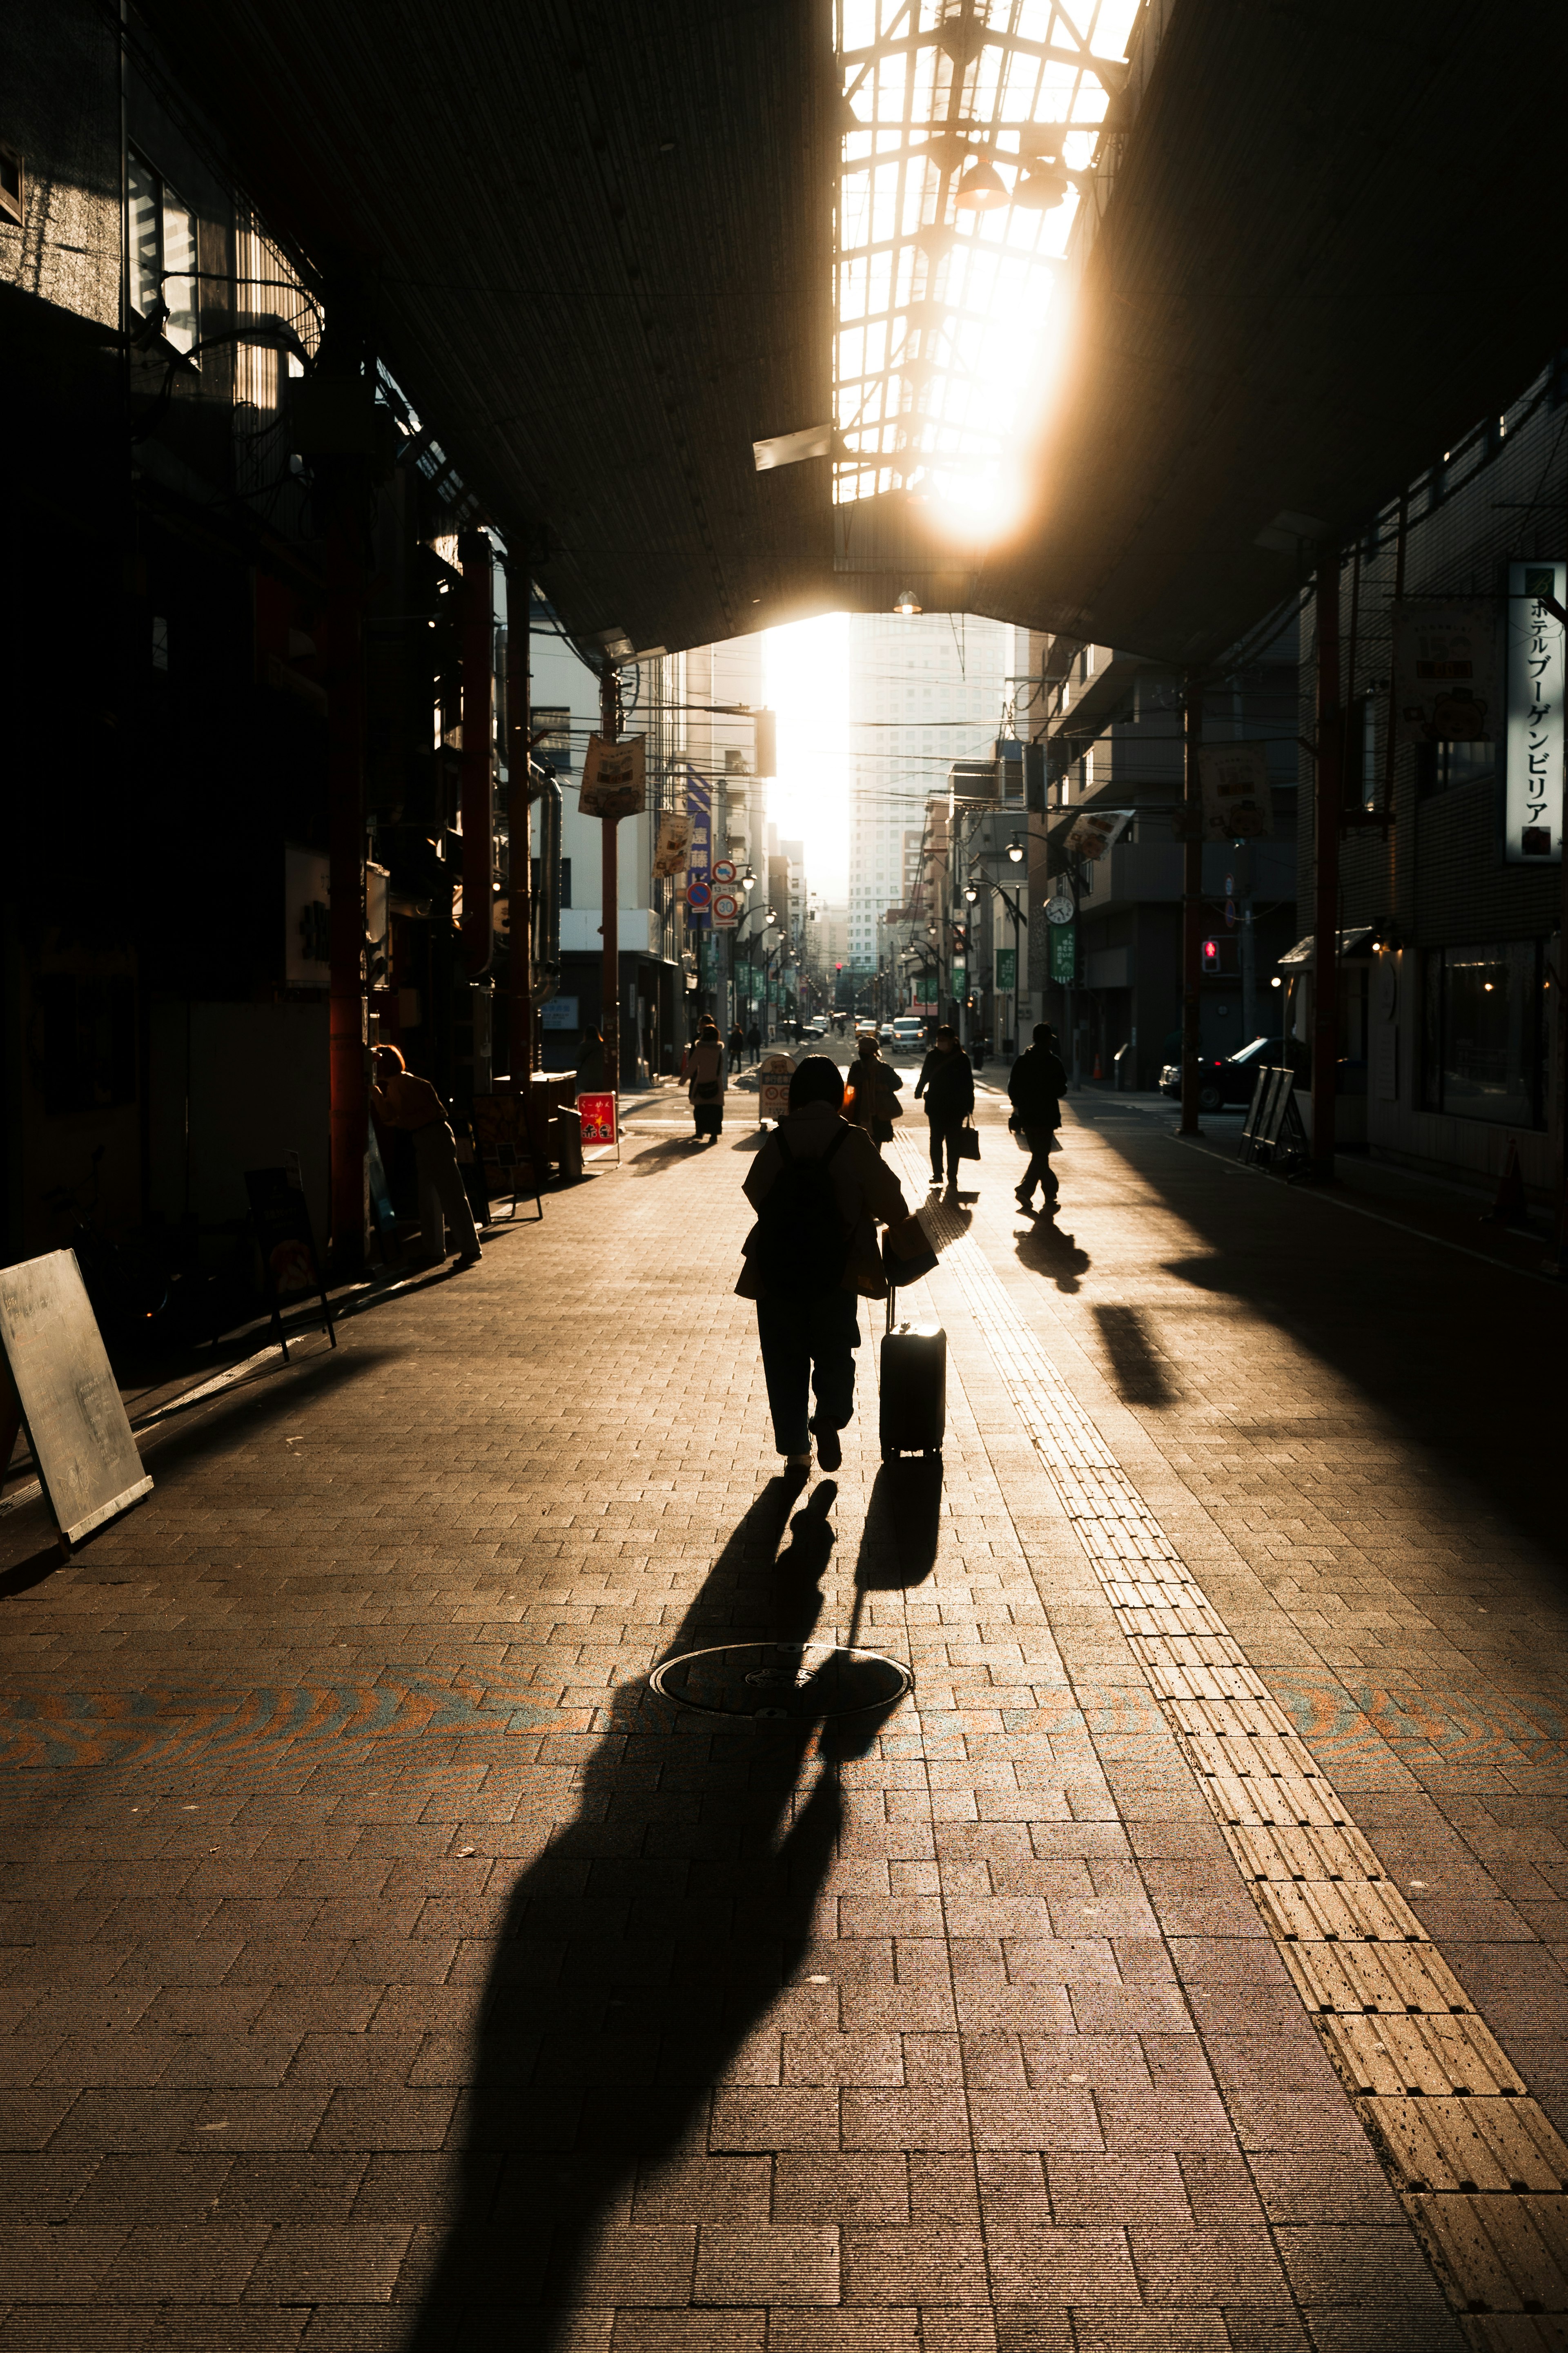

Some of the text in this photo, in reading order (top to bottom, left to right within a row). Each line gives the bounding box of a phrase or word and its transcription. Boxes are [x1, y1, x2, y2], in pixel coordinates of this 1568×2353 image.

[1527, 599, 1551, 824] ホテルブーゲンビリア
[719, 902, 733, 912] 30
[581, 1100, 610, 1108] らーめん
